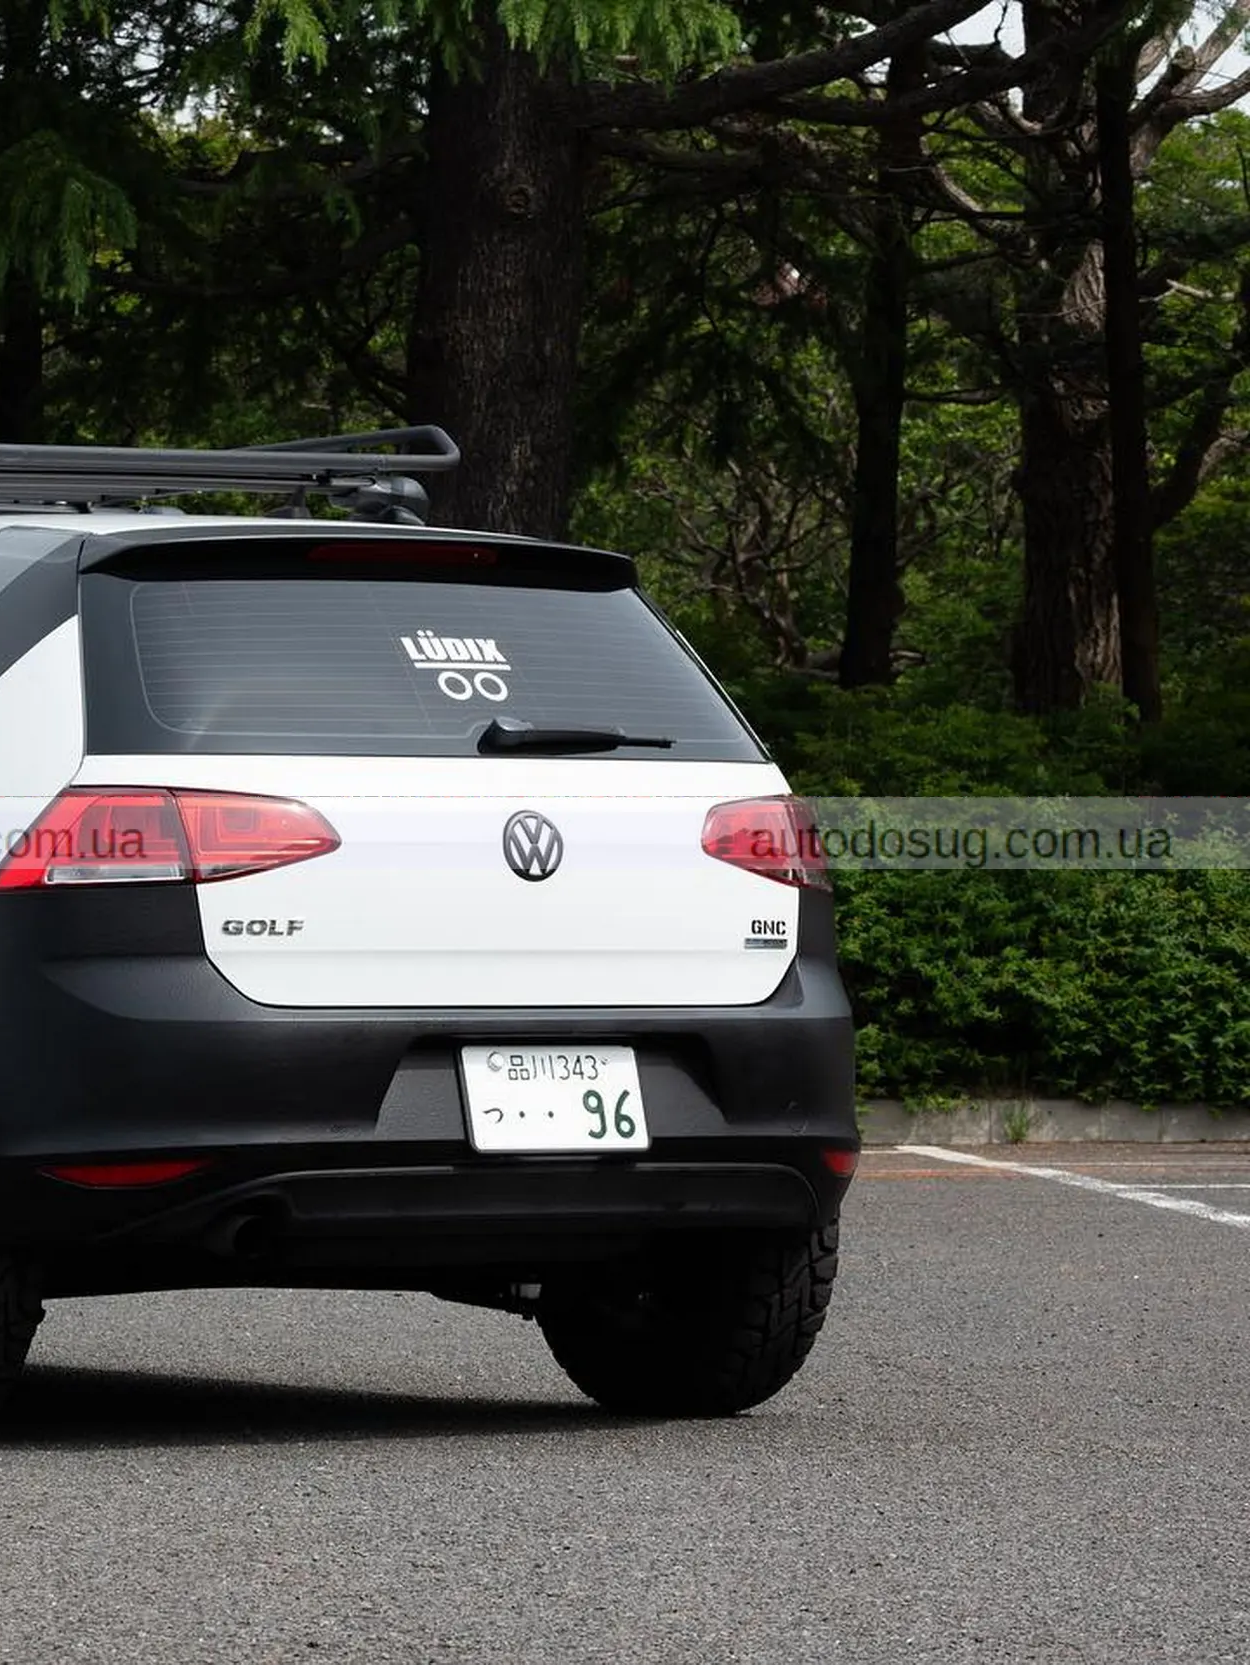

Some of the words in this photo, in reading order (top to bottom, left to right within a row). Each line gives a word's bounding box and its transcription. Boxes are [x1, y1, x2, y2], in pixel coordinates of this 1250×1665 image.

[400, 630, 507, 662] LÜDIX
[221, 919, 305, 937] GOLF
[751, 919, 786, 936] GNC
[582, 1089, 636, 1140] 96
